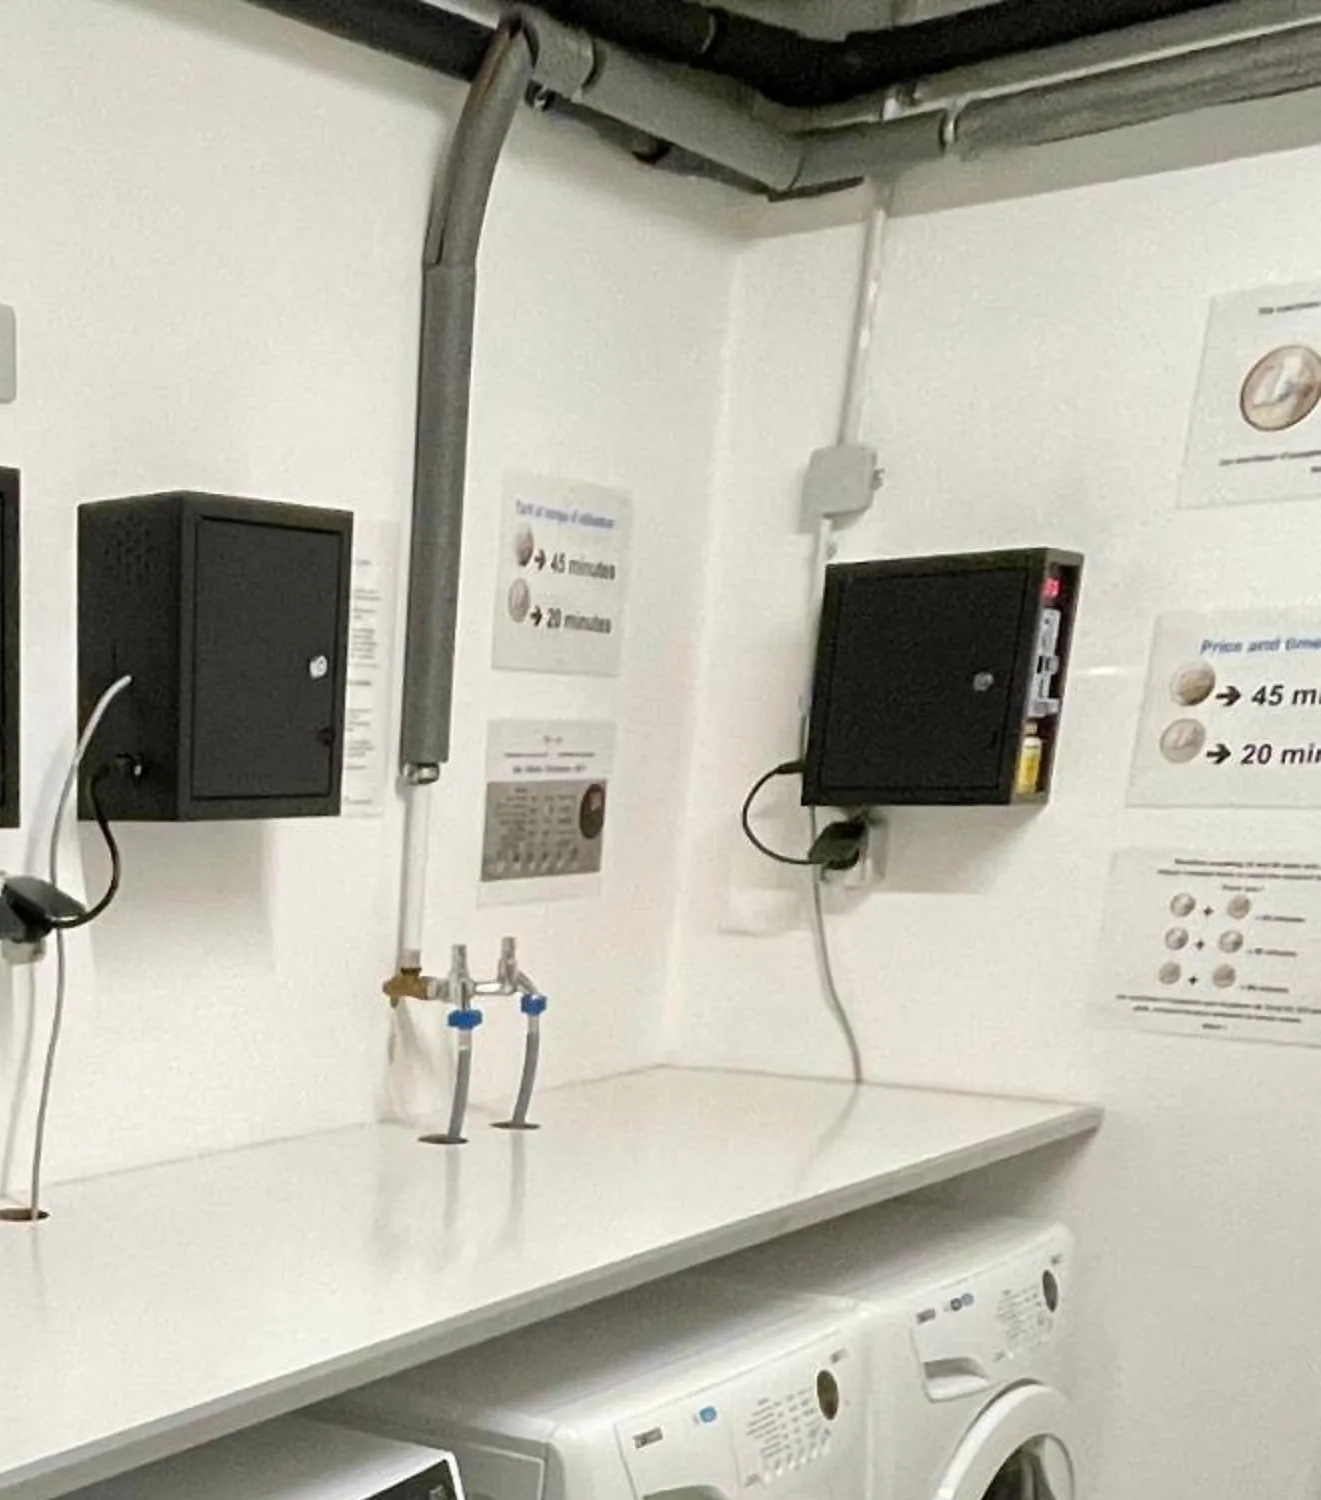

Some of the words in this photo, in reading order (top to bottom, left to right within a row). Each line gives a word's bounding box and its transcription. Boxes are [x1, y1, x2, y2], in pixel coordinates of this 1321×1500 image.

[550, 552, 566, 575] 45
[568, 556, 616, 581] minutes
[546, 607, 562, 629] 20
[564, 611, 612, 635] minutes
[1200, 638, 1244, 656] Price
[1247, 636, 1282, 653] and
[1251, 684, 1285, 707] 45
[1240, 743, 1273, 766] 20
